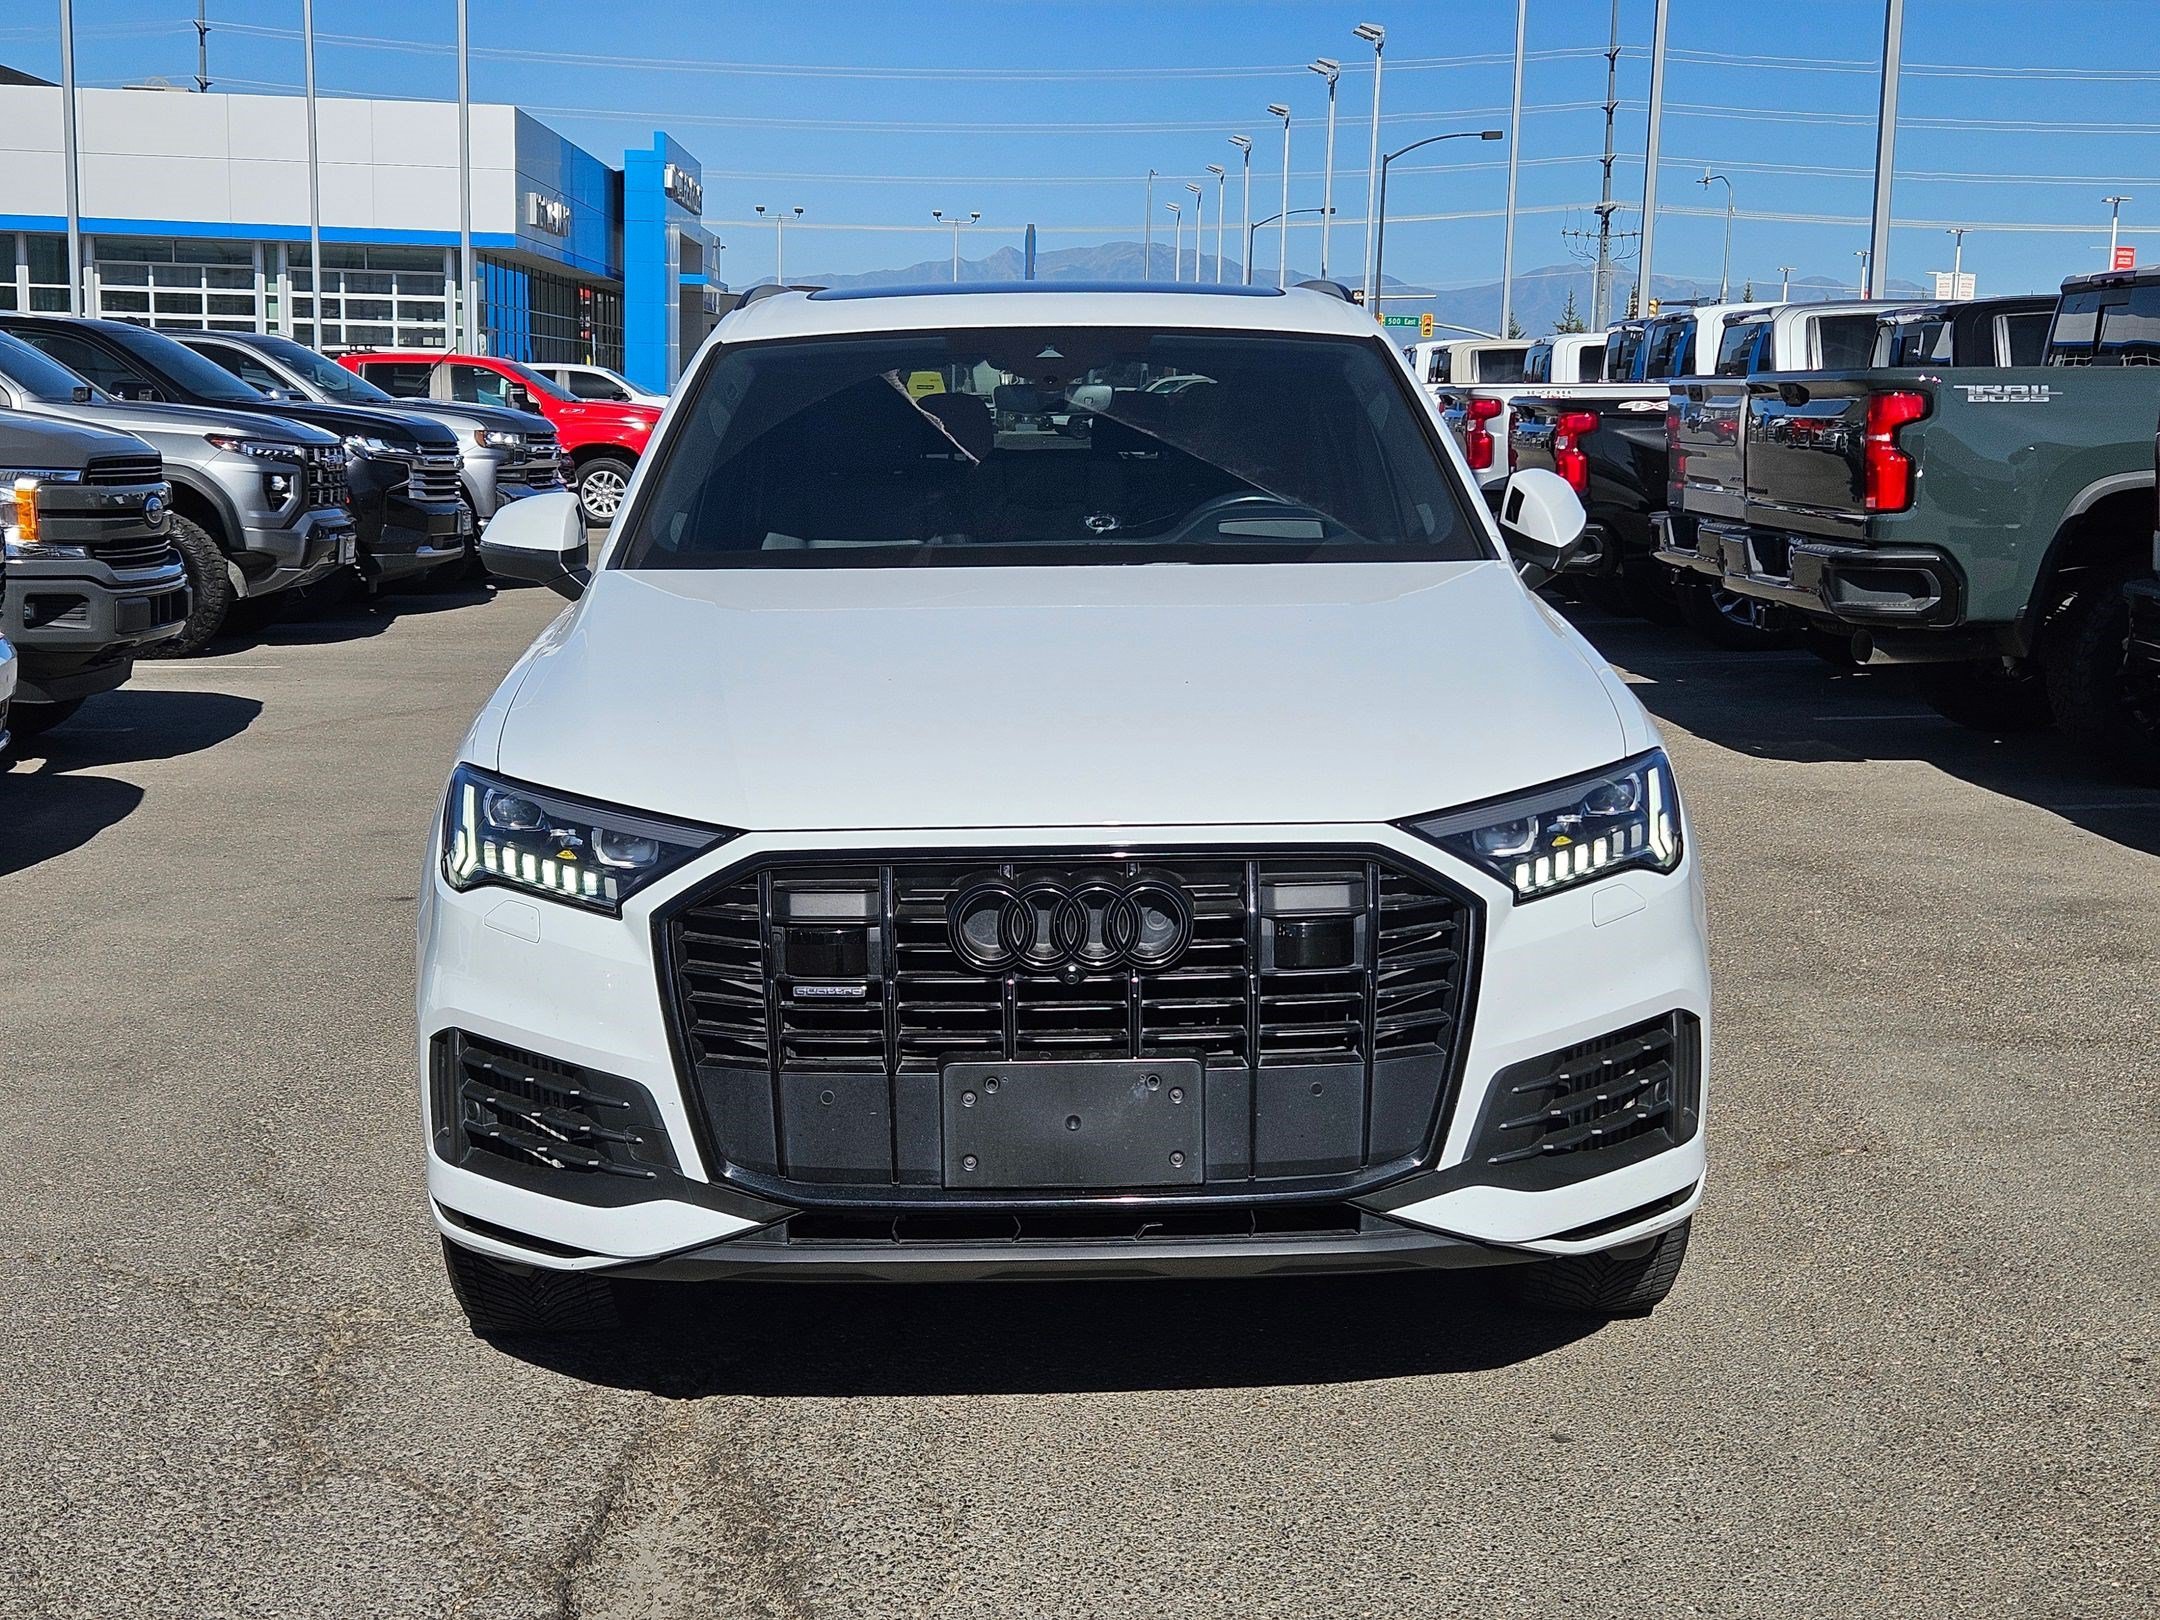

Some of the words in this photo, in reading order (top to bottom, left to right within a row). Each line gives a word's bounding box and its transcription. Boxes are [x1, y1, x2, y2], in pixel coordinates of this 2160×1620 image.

[1404, 318, 1416, 326] East
[1953, 384, 2064, 395] TRAIL
[1967, 394, 2050, 403] BOSS
[1618, 400, 1669, 411] 4X
[795, 987, 862, 996] quattro
